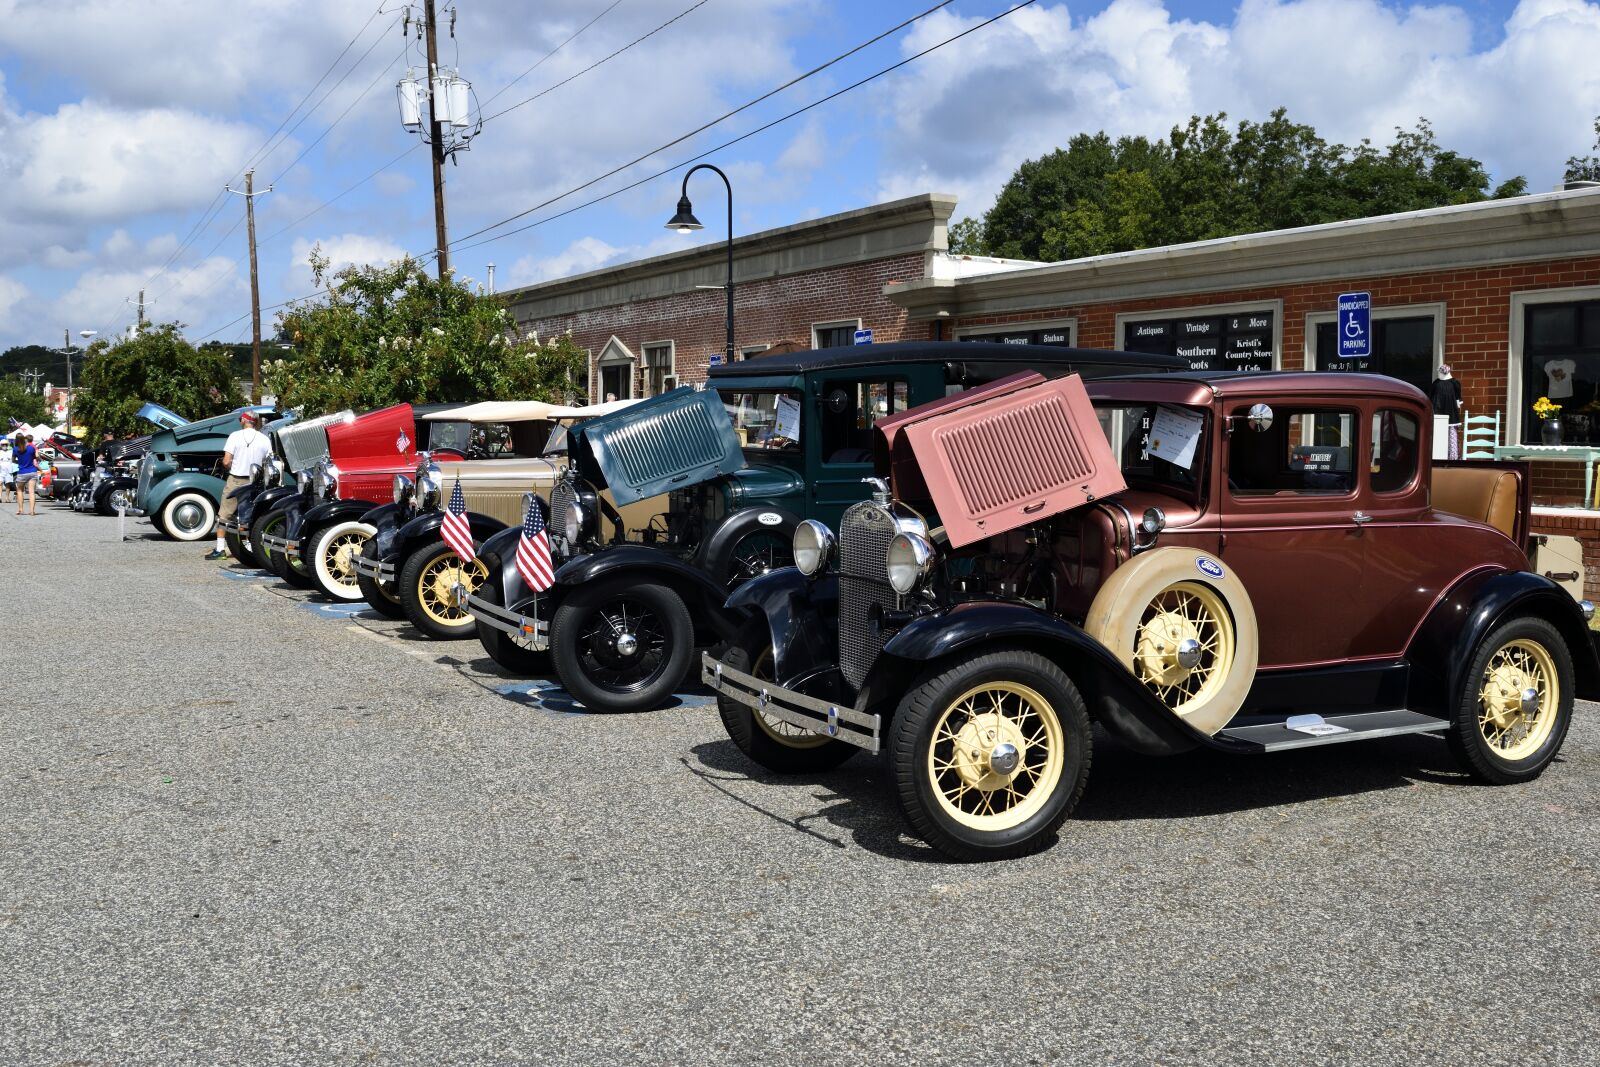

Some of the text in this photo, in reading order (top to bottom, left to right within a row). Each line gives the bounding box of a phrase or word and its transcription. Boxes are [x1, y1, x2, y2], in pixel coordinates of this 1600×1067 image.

[1340, 301, 1369, 310] HANDICAPPED
[1137, 318, 1267, 336] Antiques Vintage & More
[1043, 334, 1065, 343] Statham
[1236, 339, 1262, 348] Kristi's
[1343, 340, 1366, 349] PARKING
[1176, 346, 1217, 357] Southern
[1225, 351, 1252, 360] Country
[1188, 359, 1209, 370] oots
[1201, 561, 1220, 574] Ford
